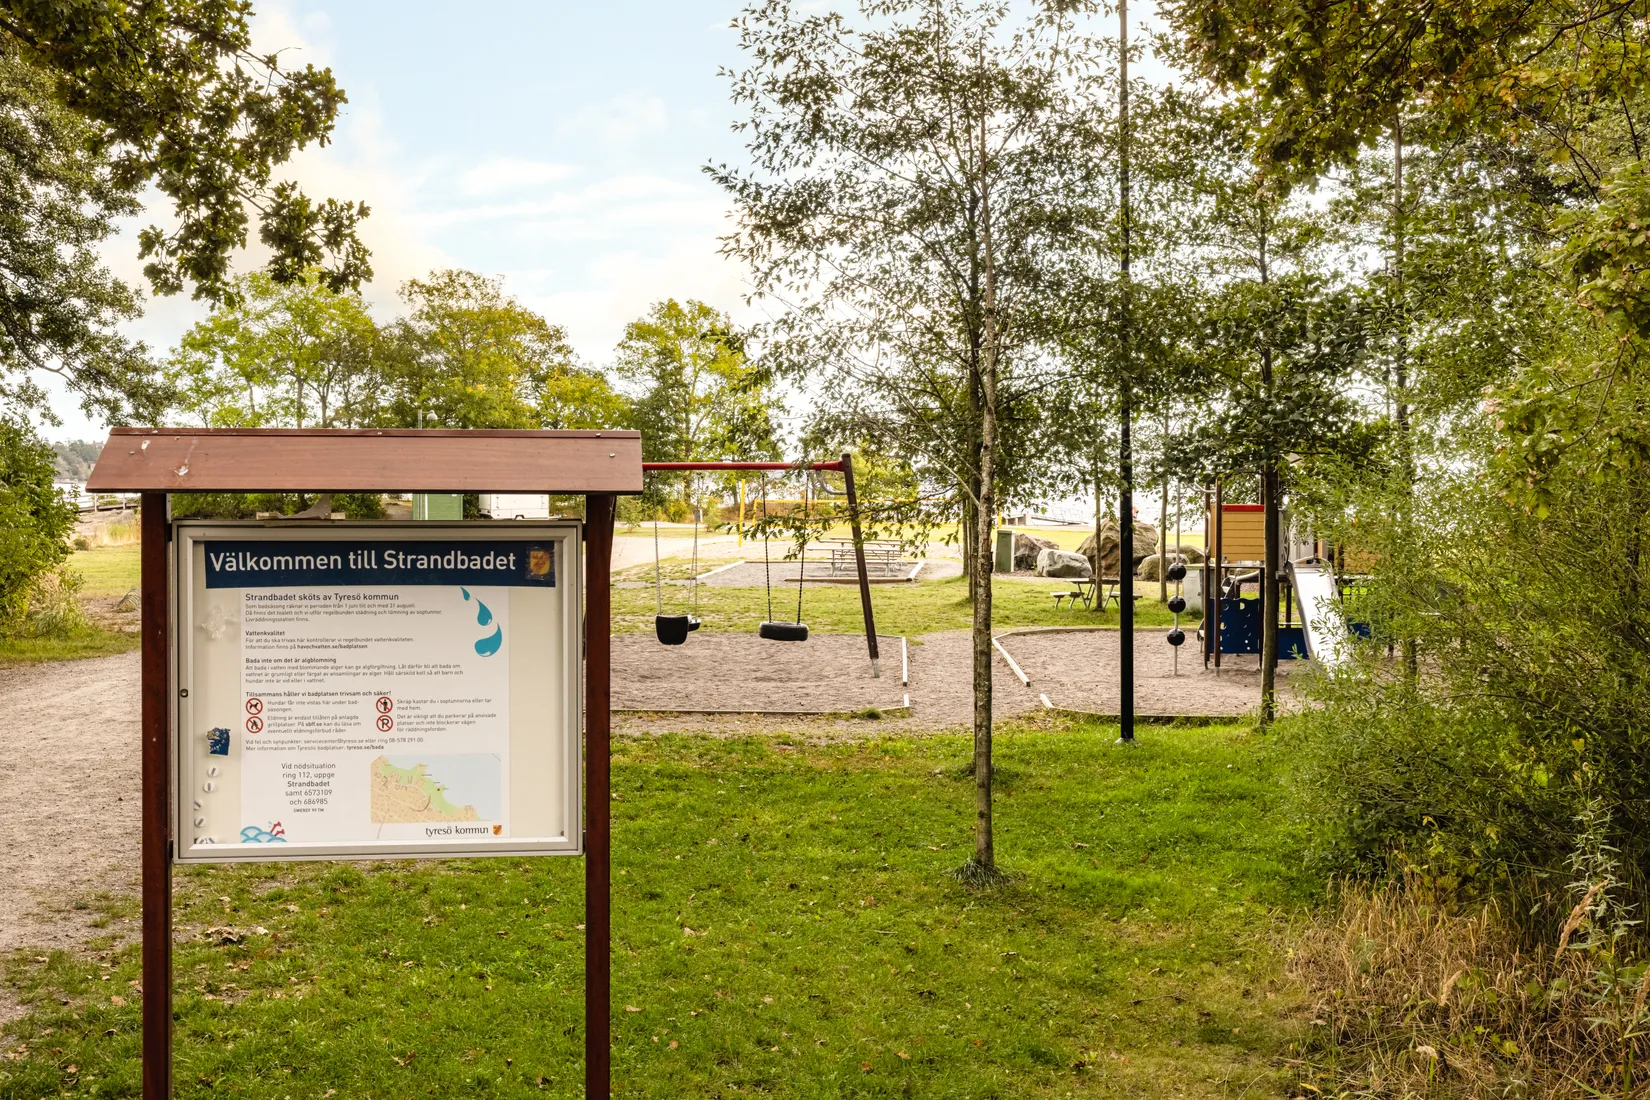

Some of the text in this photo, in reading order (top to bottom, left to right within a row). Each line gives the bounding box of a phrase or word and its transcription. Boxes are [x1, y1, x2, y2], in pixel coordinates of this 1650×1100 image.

[210, 550, 516, 571] Välkommen till Strandbadet
[334, 593, 361, 602] Tyresö
[282, 772, 296, 780] ring
[426, 825, 488, 837] tyresö kommun
